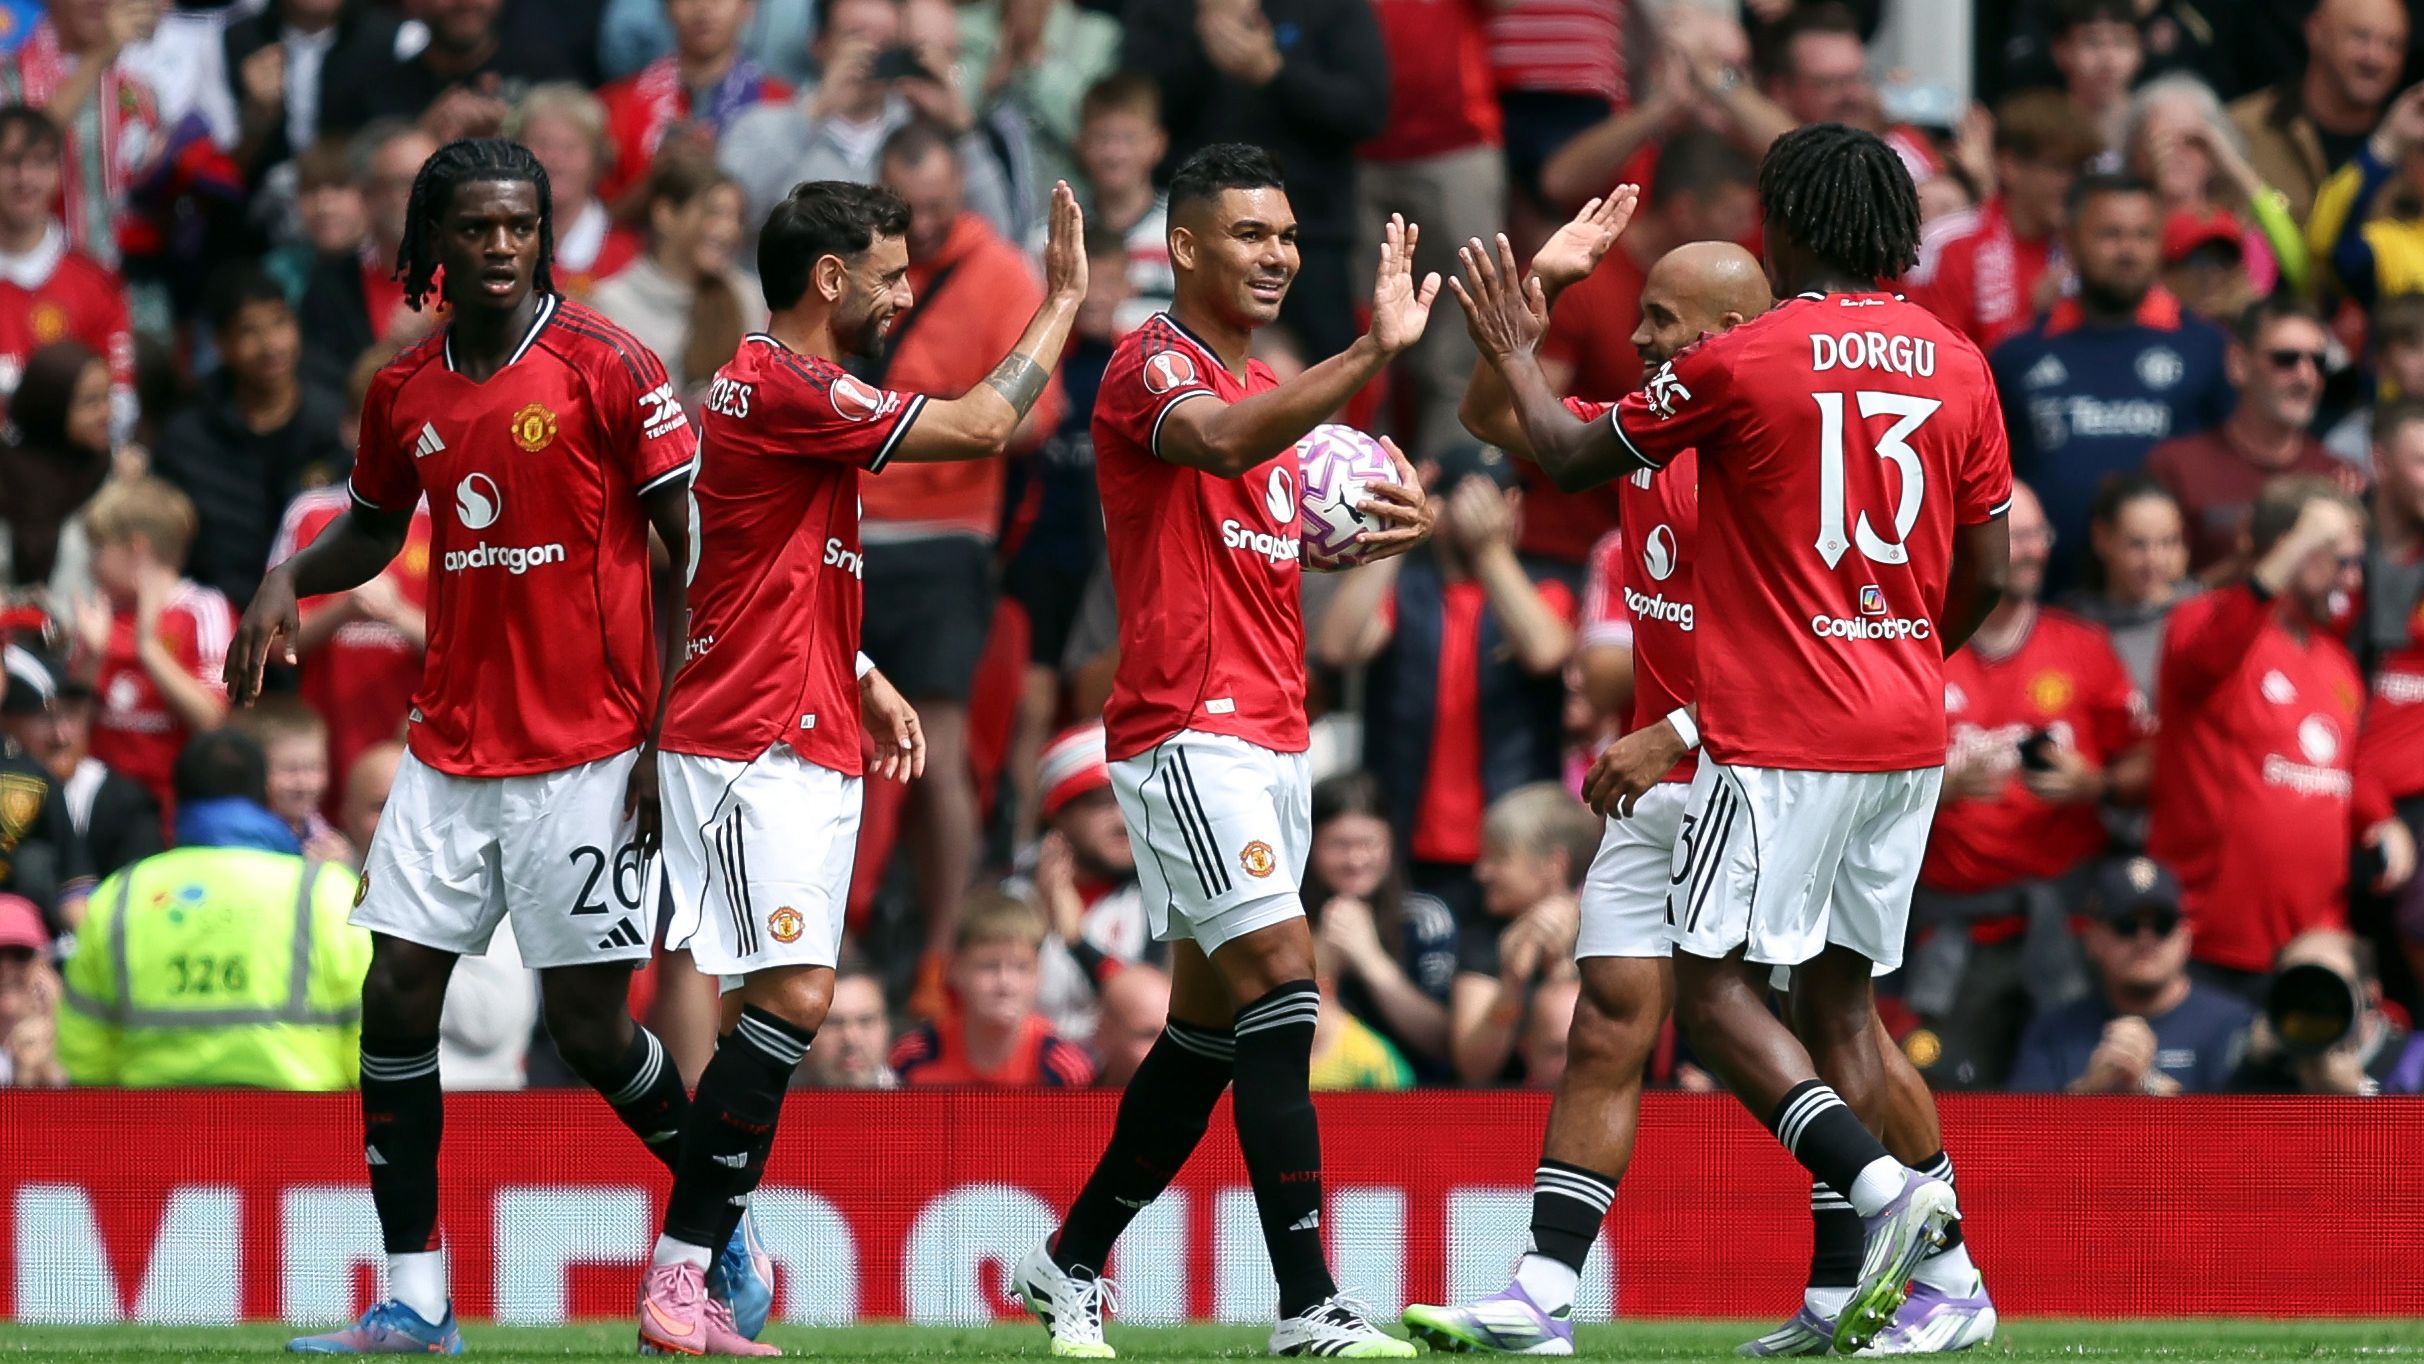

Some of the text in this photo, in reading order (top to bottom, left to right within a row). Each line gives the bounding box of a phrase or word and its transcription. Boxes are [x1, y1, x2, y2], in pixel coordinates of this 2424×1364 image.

[1809, 331, 1935, 378] DORGU
[705, 378, 752, 418] DES
[1811, 391, 1943, 570] 13
[1222, 519, 1299, 564] Snapdr
[569, 842, 642, 915] 26
[1669, 813, 1698, 885] 3
